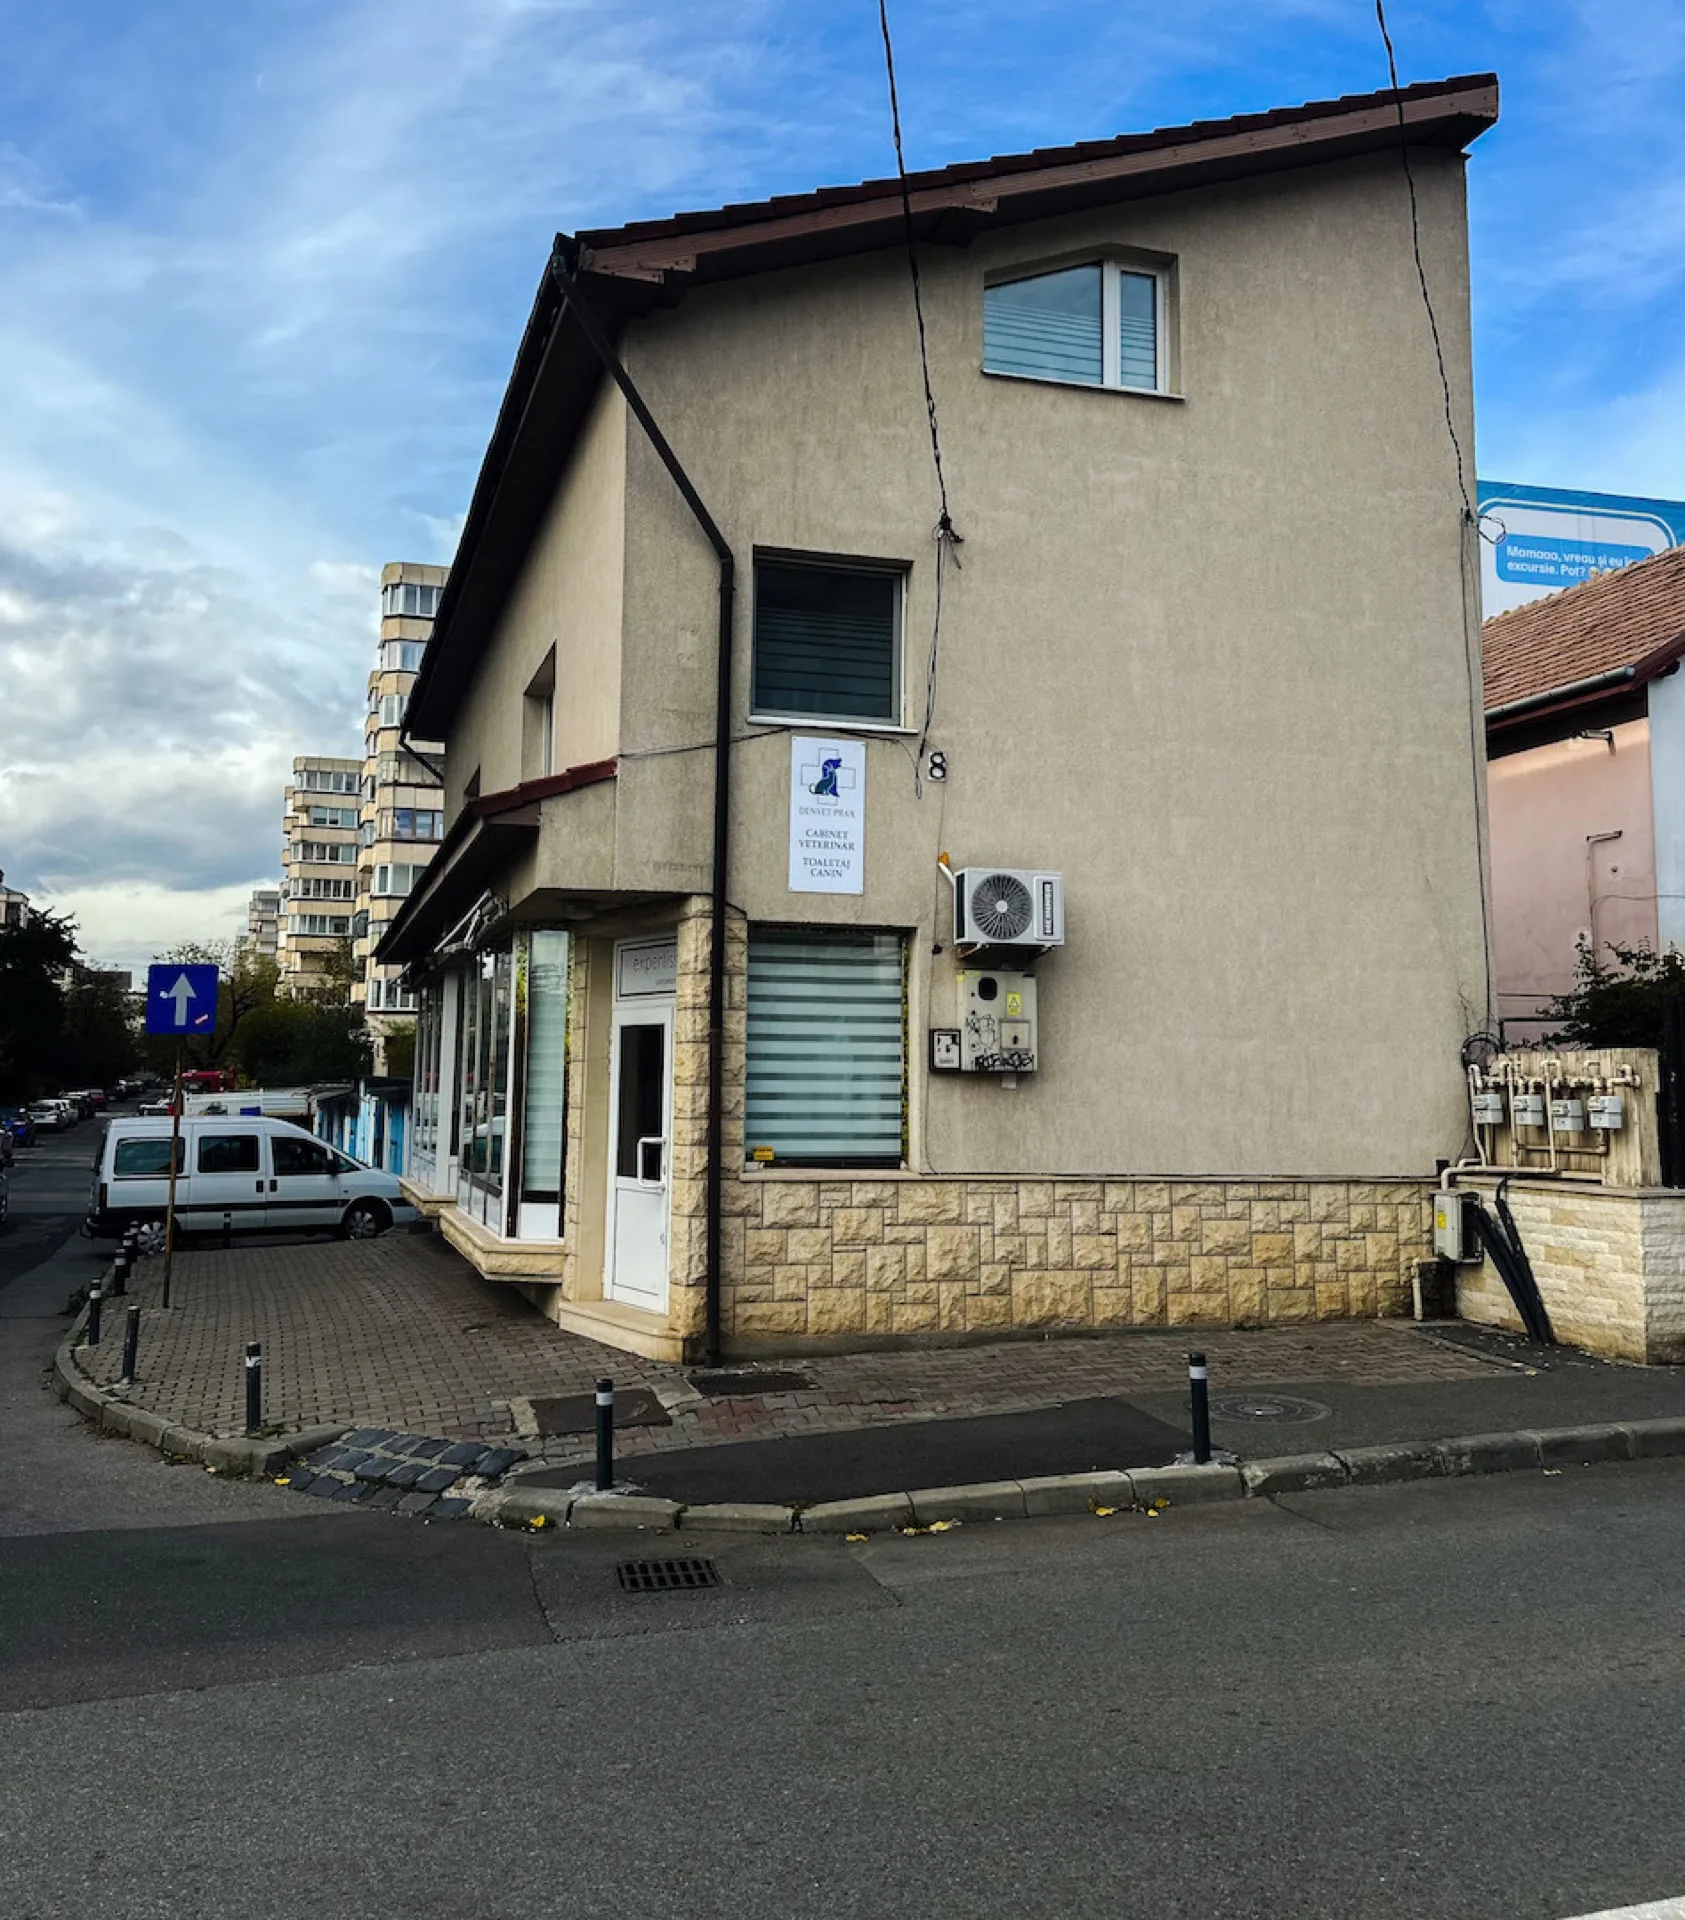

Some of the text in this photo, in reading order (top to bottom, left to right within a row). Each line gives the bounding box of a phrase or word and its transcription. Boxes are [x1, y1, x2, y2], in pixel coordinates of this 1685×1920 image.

[1563, 553, 1595, 565] vreau
[1609, 557, 1623, 567] eu
[1560, 563, 1585, 577] Pot?
[929, 752, 947, 780] 8
[805, 828, 849, 839] CABINET
[799, 839, 855, 851] VETERINAR
[802, 857, 851, 870] TOALETAJ
[810, 867, 842, 878] CANIN
